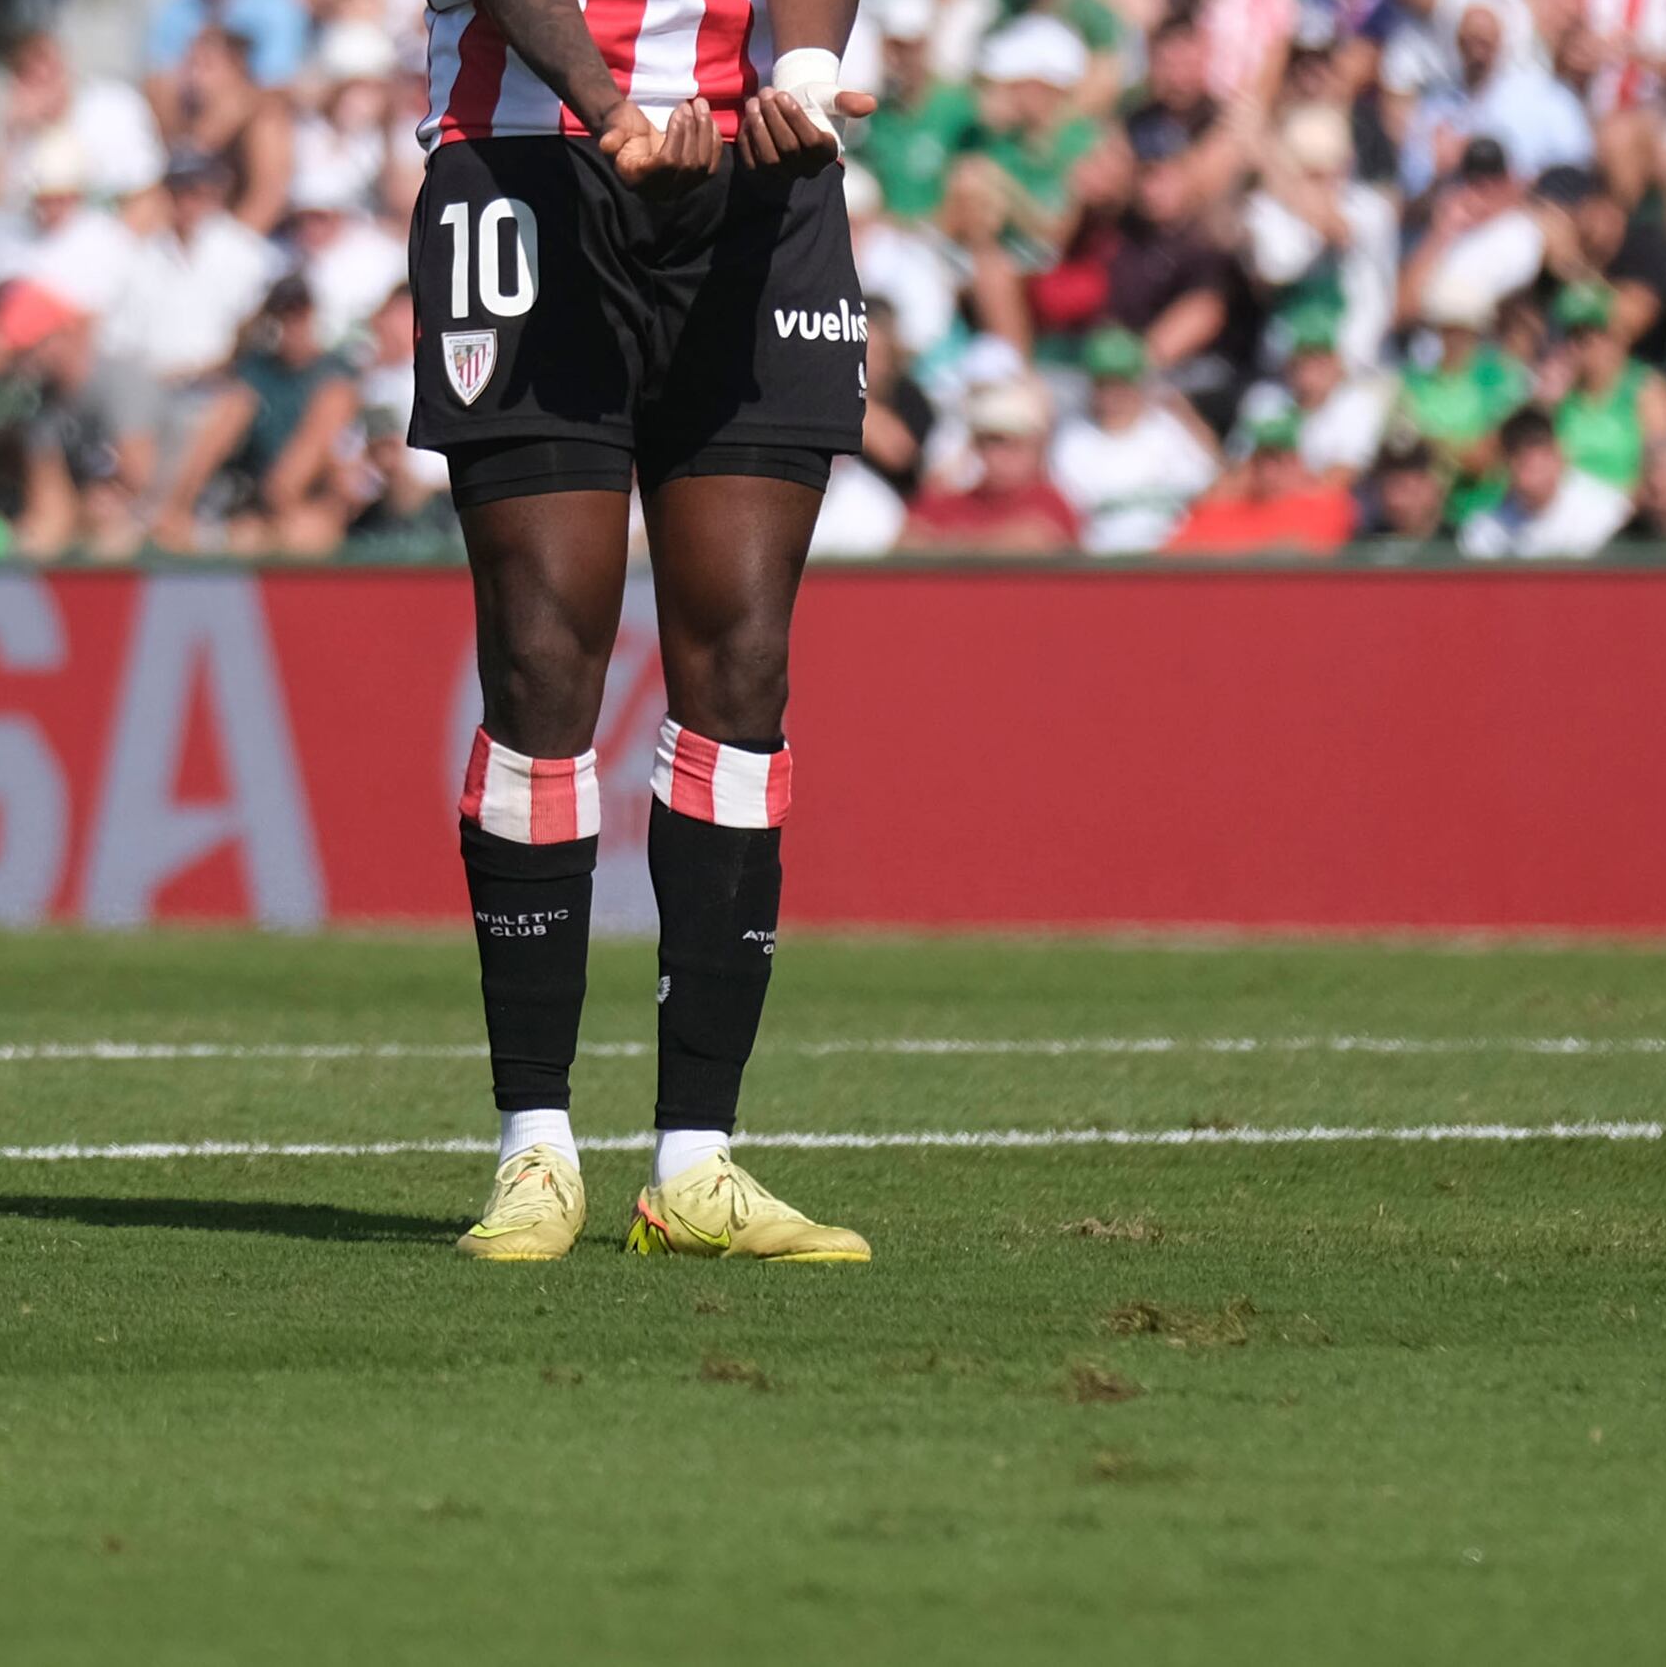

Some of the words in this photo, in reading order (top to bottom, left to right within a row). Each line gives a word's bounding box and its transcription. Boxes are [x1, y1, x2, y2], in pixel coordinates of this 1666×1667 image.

[439, 197, 539, 319] 10
[475, 909, 569, 925] ATHLETIC
[490, 925, 547, 937] CLUB
